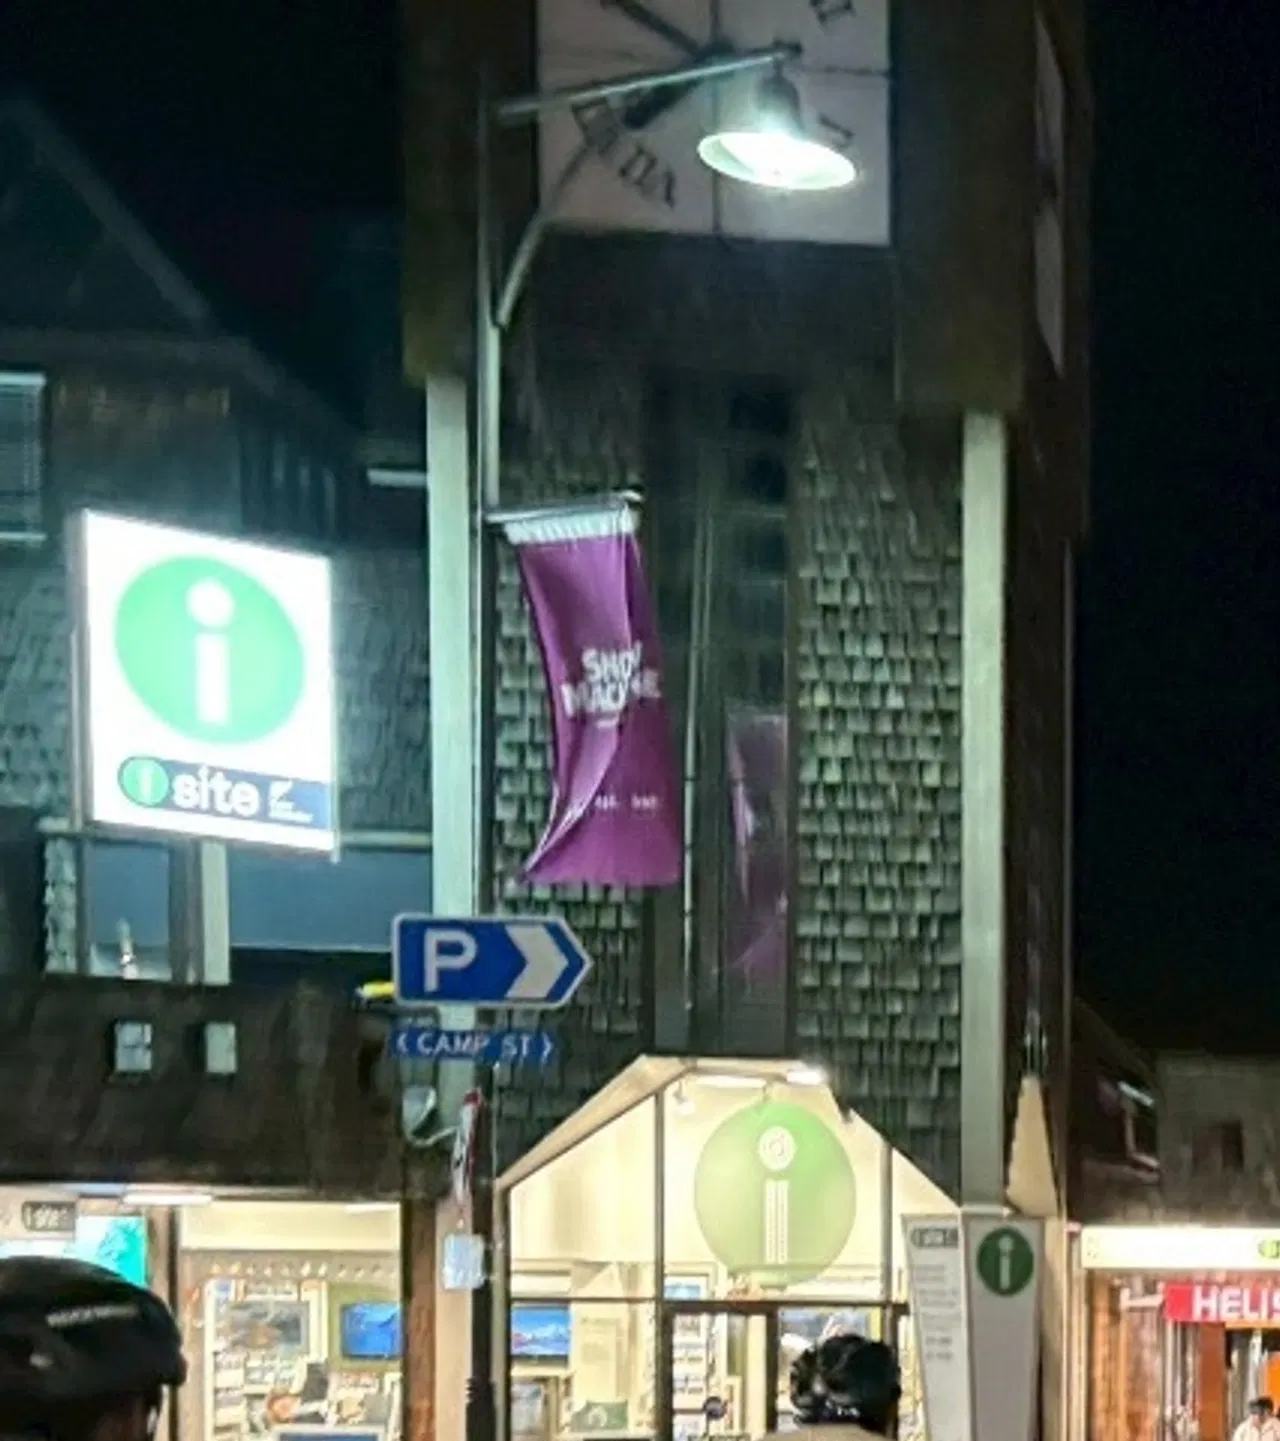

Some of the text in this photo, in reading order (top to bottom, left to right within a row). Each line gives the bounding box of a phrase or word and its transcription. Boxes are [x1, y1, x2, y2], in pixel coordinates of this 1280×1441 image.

[424, 928, 478, 993] P
[417, 1033, 533, 1058] CAMP ST
